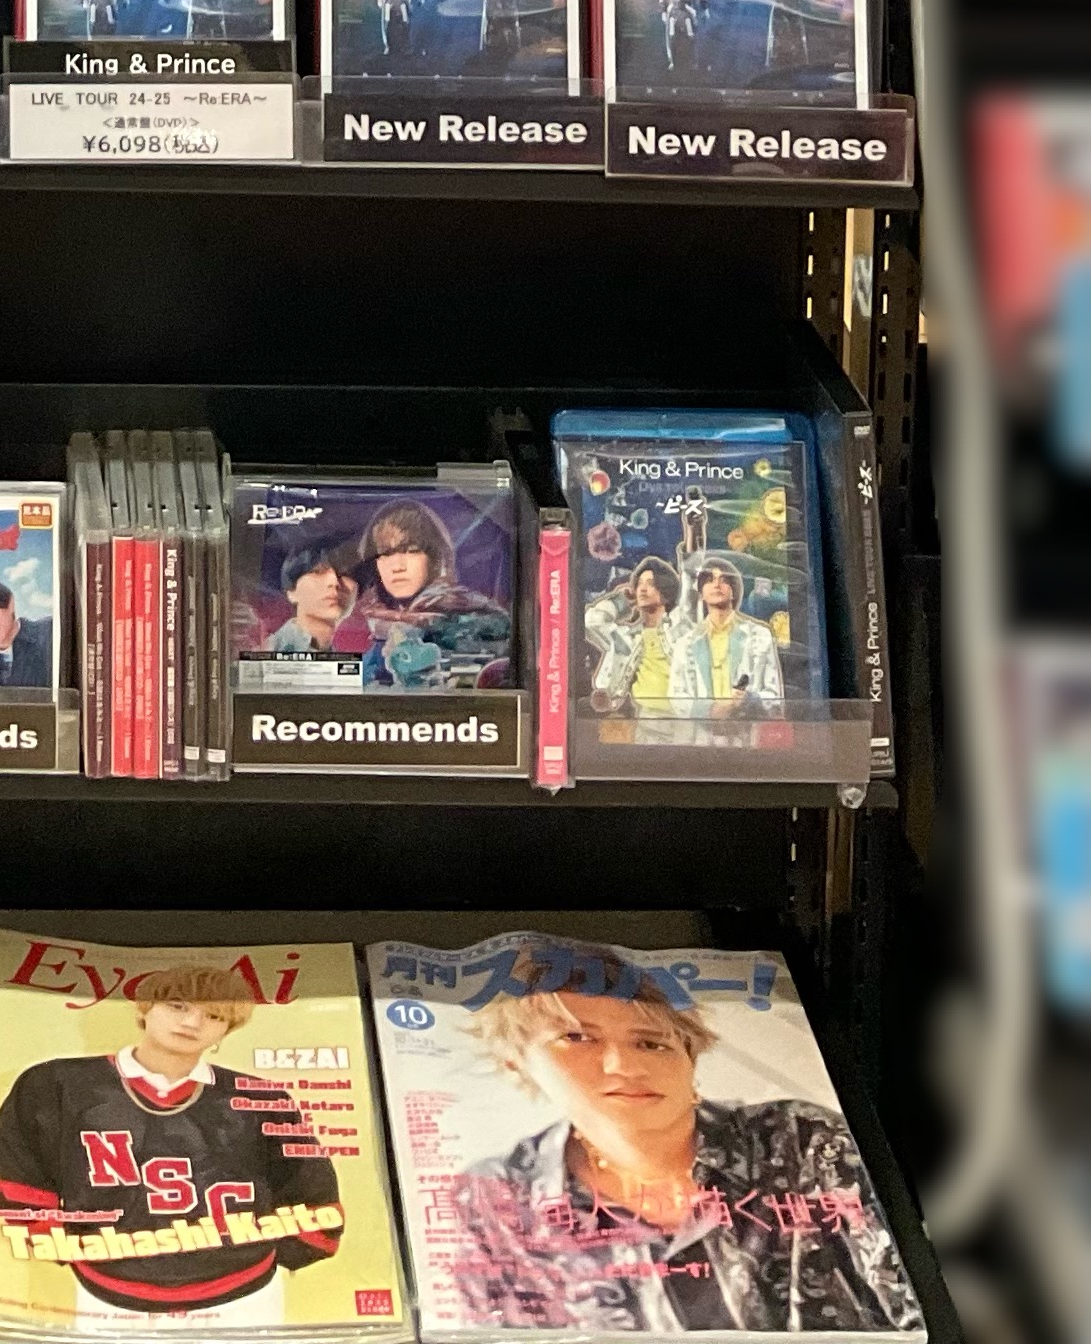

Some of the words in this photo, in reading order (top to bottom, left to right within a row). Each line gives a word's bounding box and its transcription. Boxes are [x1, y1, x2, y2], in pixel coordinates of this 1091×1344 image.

[65, 53, 119, 75] King
[129, 54, 148, 73] &
[156, 53, 236, 73] Prince
[31, 91, 64, 106] LIVE
[76, 91, 118, 105] TOUR
[129, 91, 171, 105] 24-25
[343, 114, 426, 143] New
[438, 114, 588, 144] Release
[628, 126, 716, 157] New
[728, 127, 888, 162] Release
[619, 459, 661, 479] King
[665, 461, 681, 477] &
[685, 461, 744, 479] Prince
[164, 549, 178, 576] King
[165, 593, 178, 632] Prince
[866, 602, 880, 650] Prince
[868, 669, 885, 702] King
[251, 714, 500, 744] Recommends
[394, 1004, 429, 1025] 10
[3, 1215, 224, 1262] Takahashi
[228, 1202, 344, 1246] Kaito
